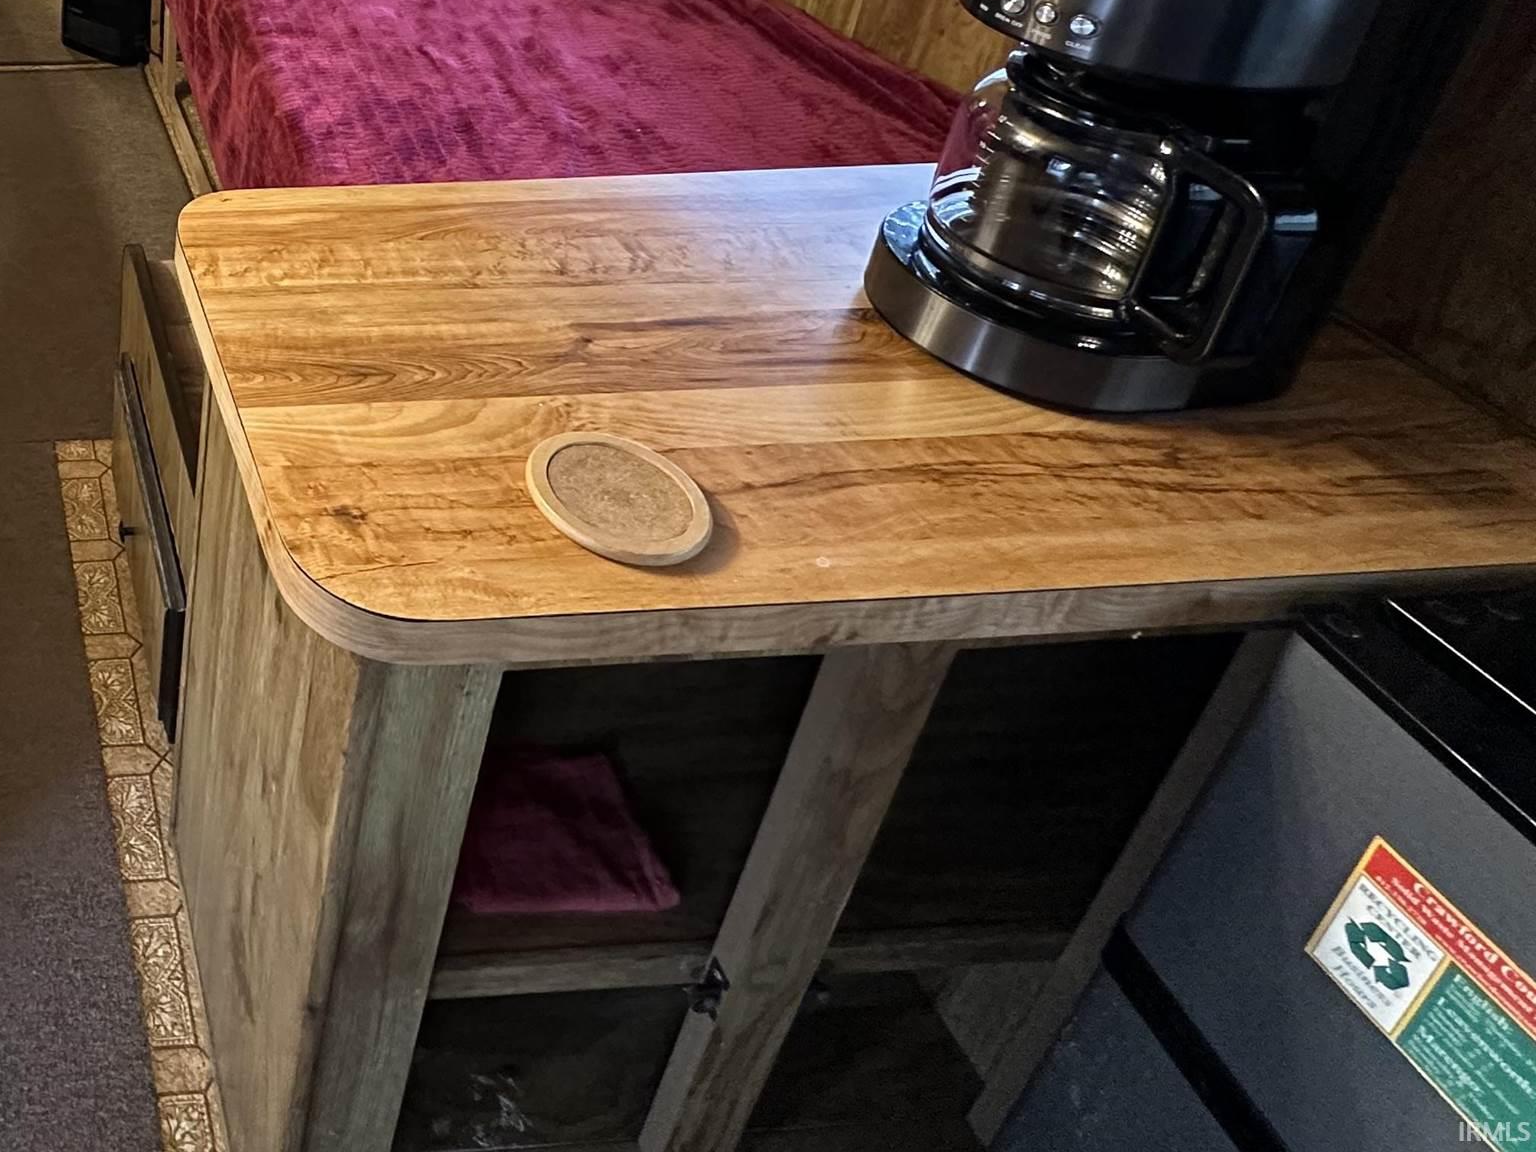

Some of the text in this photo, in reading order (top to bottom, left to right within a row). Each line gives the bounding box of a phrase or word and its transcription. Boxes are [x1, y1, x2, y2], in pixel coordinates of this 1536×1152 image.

[1358, 882, 1439, 962] RECYCLING
[1365, 902, 1421, 960] CENTER
[1390, 876, 1534, 1015] Solid Waste Management
[1411, 880, 1498, 964] Crawford
[1331, 941, 1393, 1009] Business
[1333, 961, 1378, 1011] Hours
